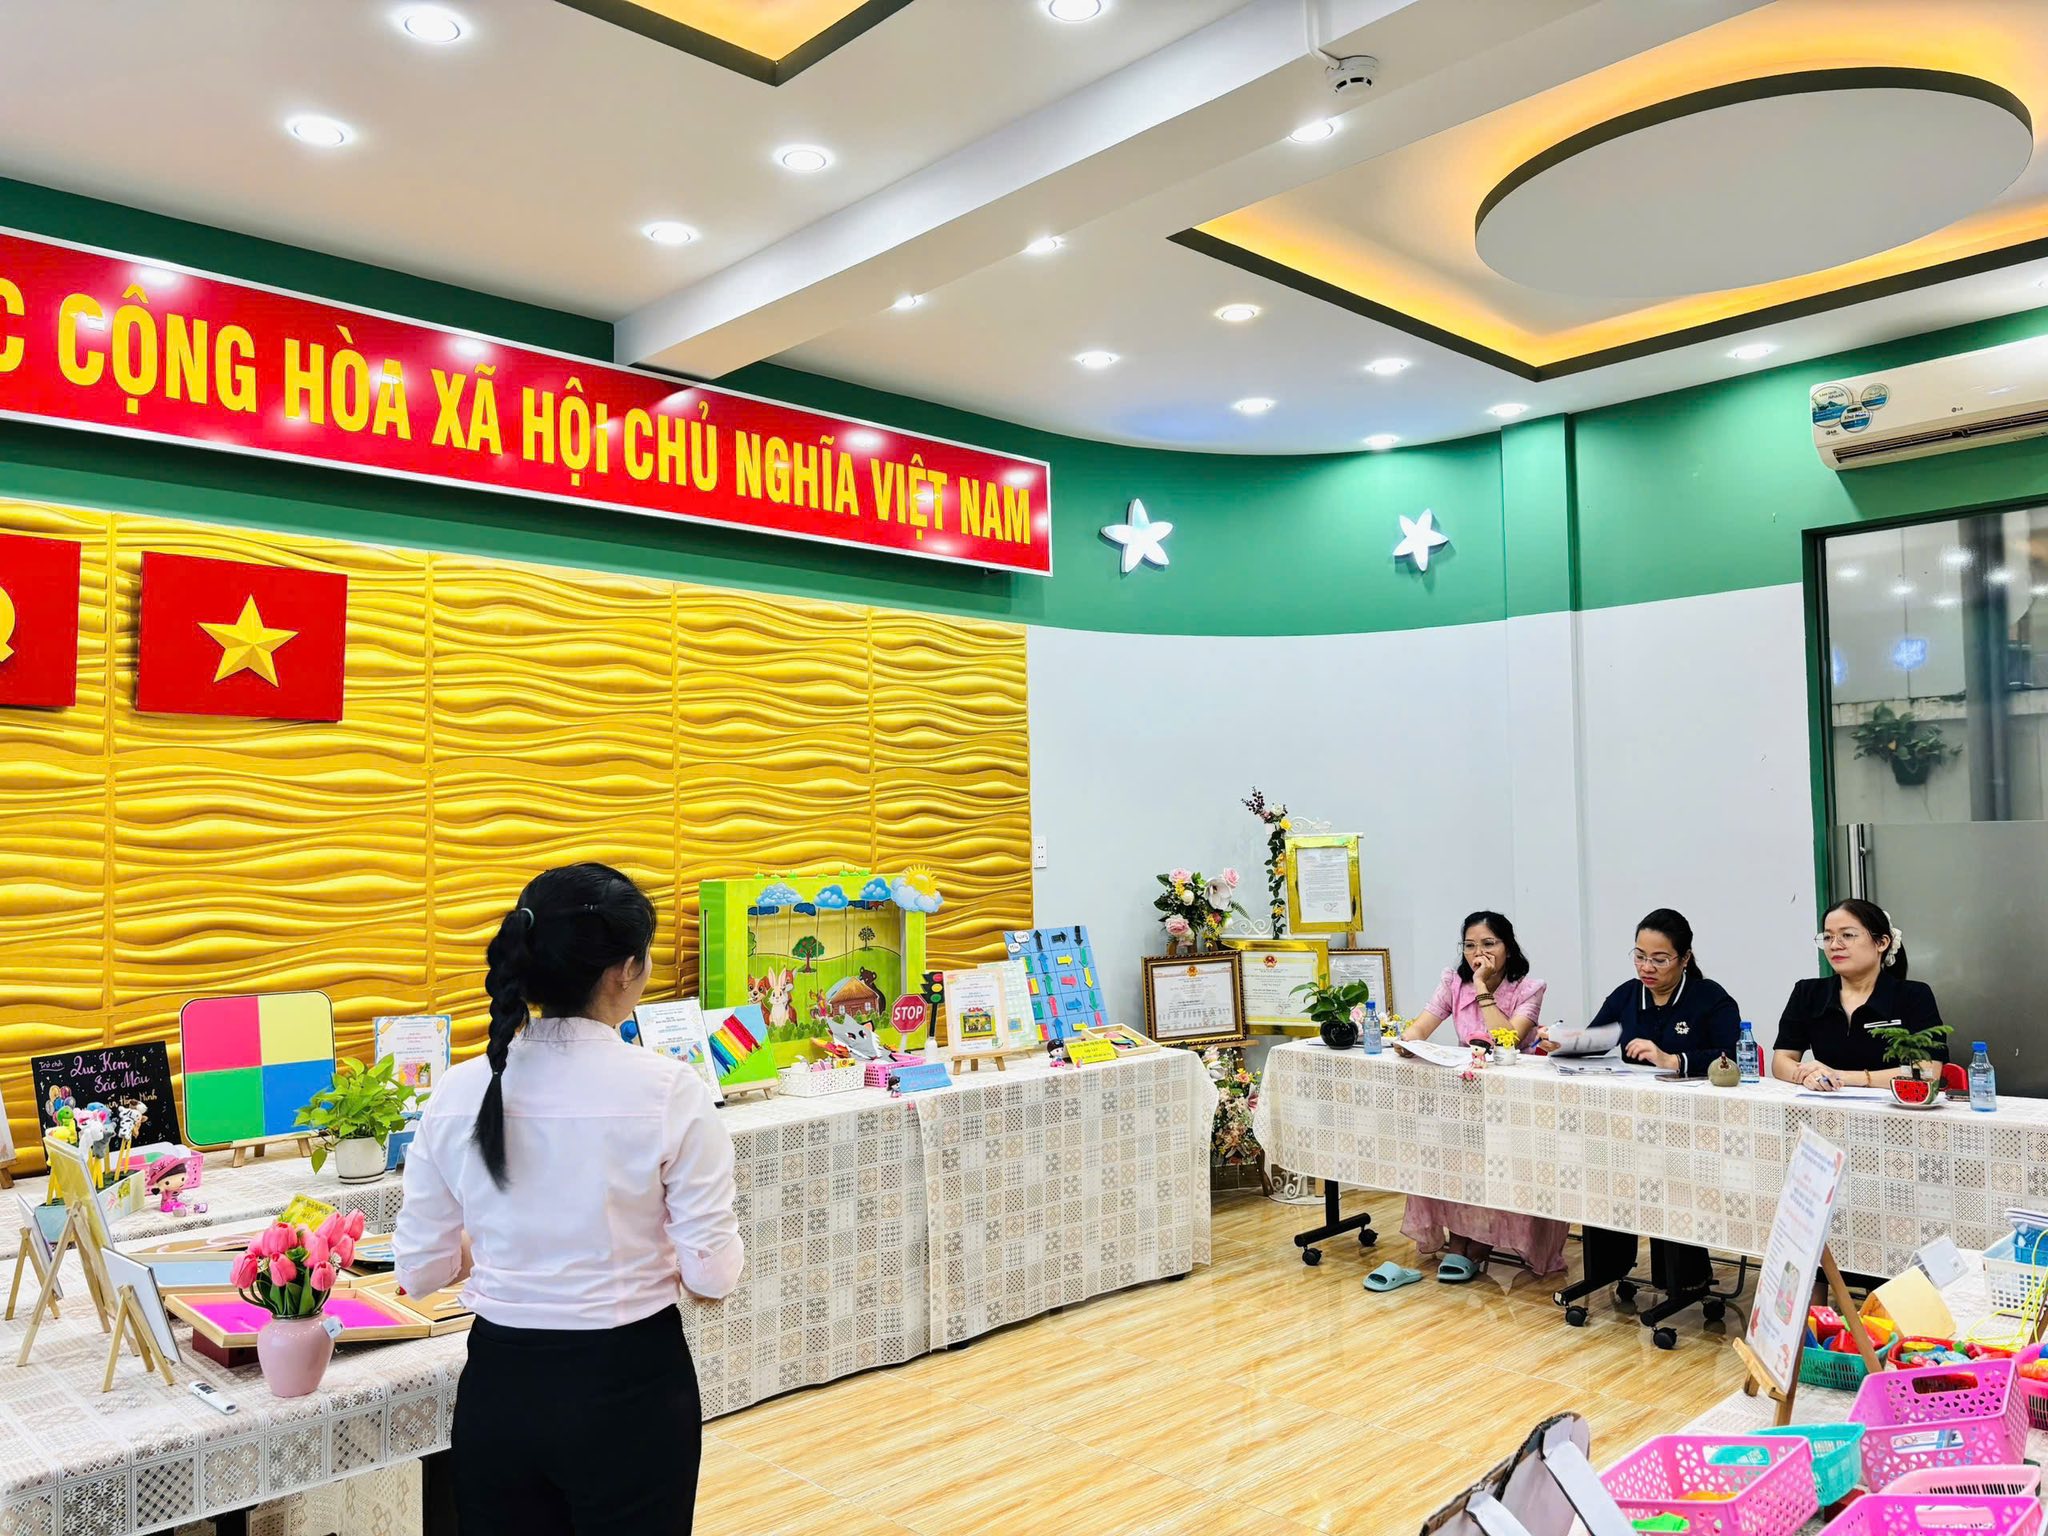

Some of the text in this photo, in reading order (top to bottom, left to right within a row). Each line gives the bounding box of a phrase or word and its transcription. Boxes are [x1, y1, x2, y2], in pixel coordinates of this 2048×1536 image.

[58, 284, 257, 414] CỘNG
[284, 324, 411, 440] HÒA
[431, 363, 503, 456] XÃ
[523, 377, 609, 486] HỘI
[624, 401, 718, 492] CHỦ
[735, 435, 860, 516] NGHĨA
[870, 453, 948, 540] VIỆT
[959, 476, 1031, 545] NAM
[894, 1006, 923, 1021] STOP
[98, 1051, 131, 1074] Kem
[120, 1070, 151, 1089] Màu
